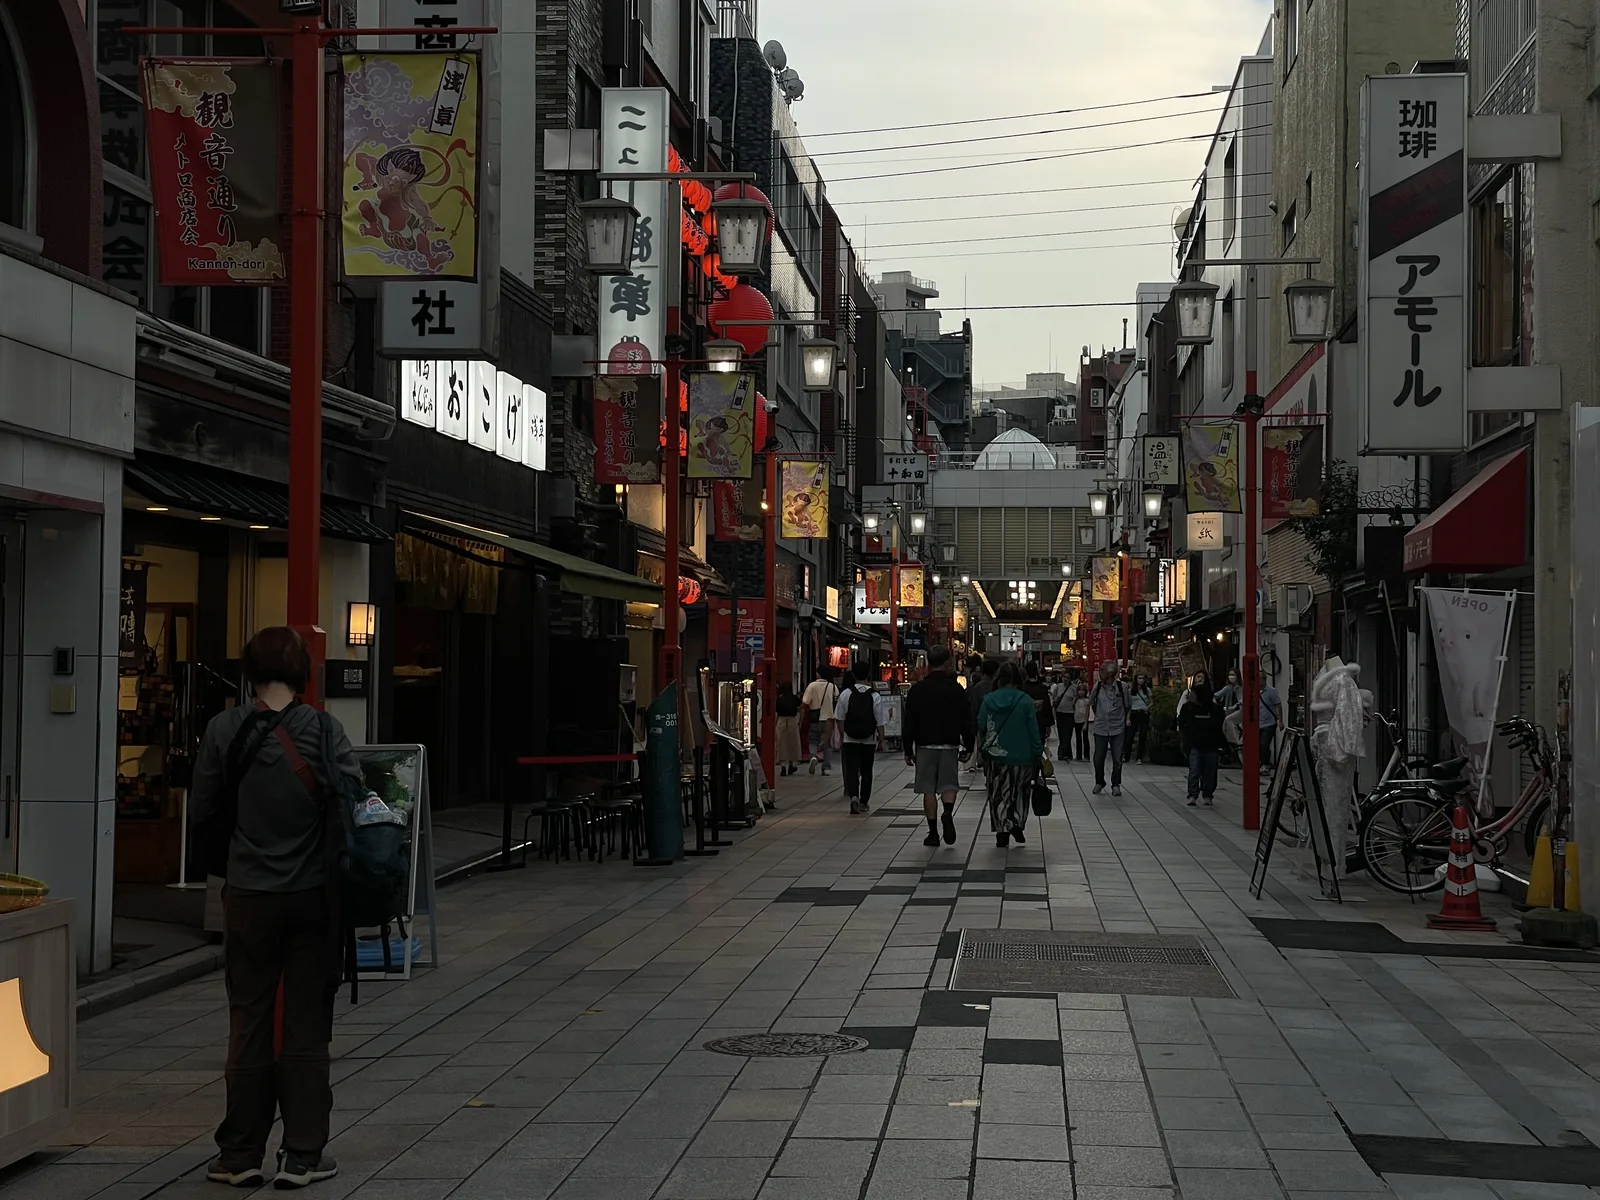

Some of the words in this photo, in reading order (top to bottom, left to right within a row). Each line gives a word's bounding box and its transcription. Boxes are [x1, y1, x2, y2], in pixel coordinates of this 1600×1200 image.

[1398, 100, 1437, 159] 珈琲
[174, 132, 199, 246] メトロ商店会
[196, 91, 238, 247] 観音通り
[188, 258, 265, 270] Kannon-dori
[411, 289, 455, 336] 社
[1393, 255, 1441, 408] アモール
[412, 382, 433, 416] もんじゃ
[447, 360, 521, 445] おこげ
[618, 390, 637, 465] 観音通り
[888, 467, 924, 479] 十和田
[1283, 439, 1301, 500] 観音通り
[1198, 527, 1214, 540] 紙
